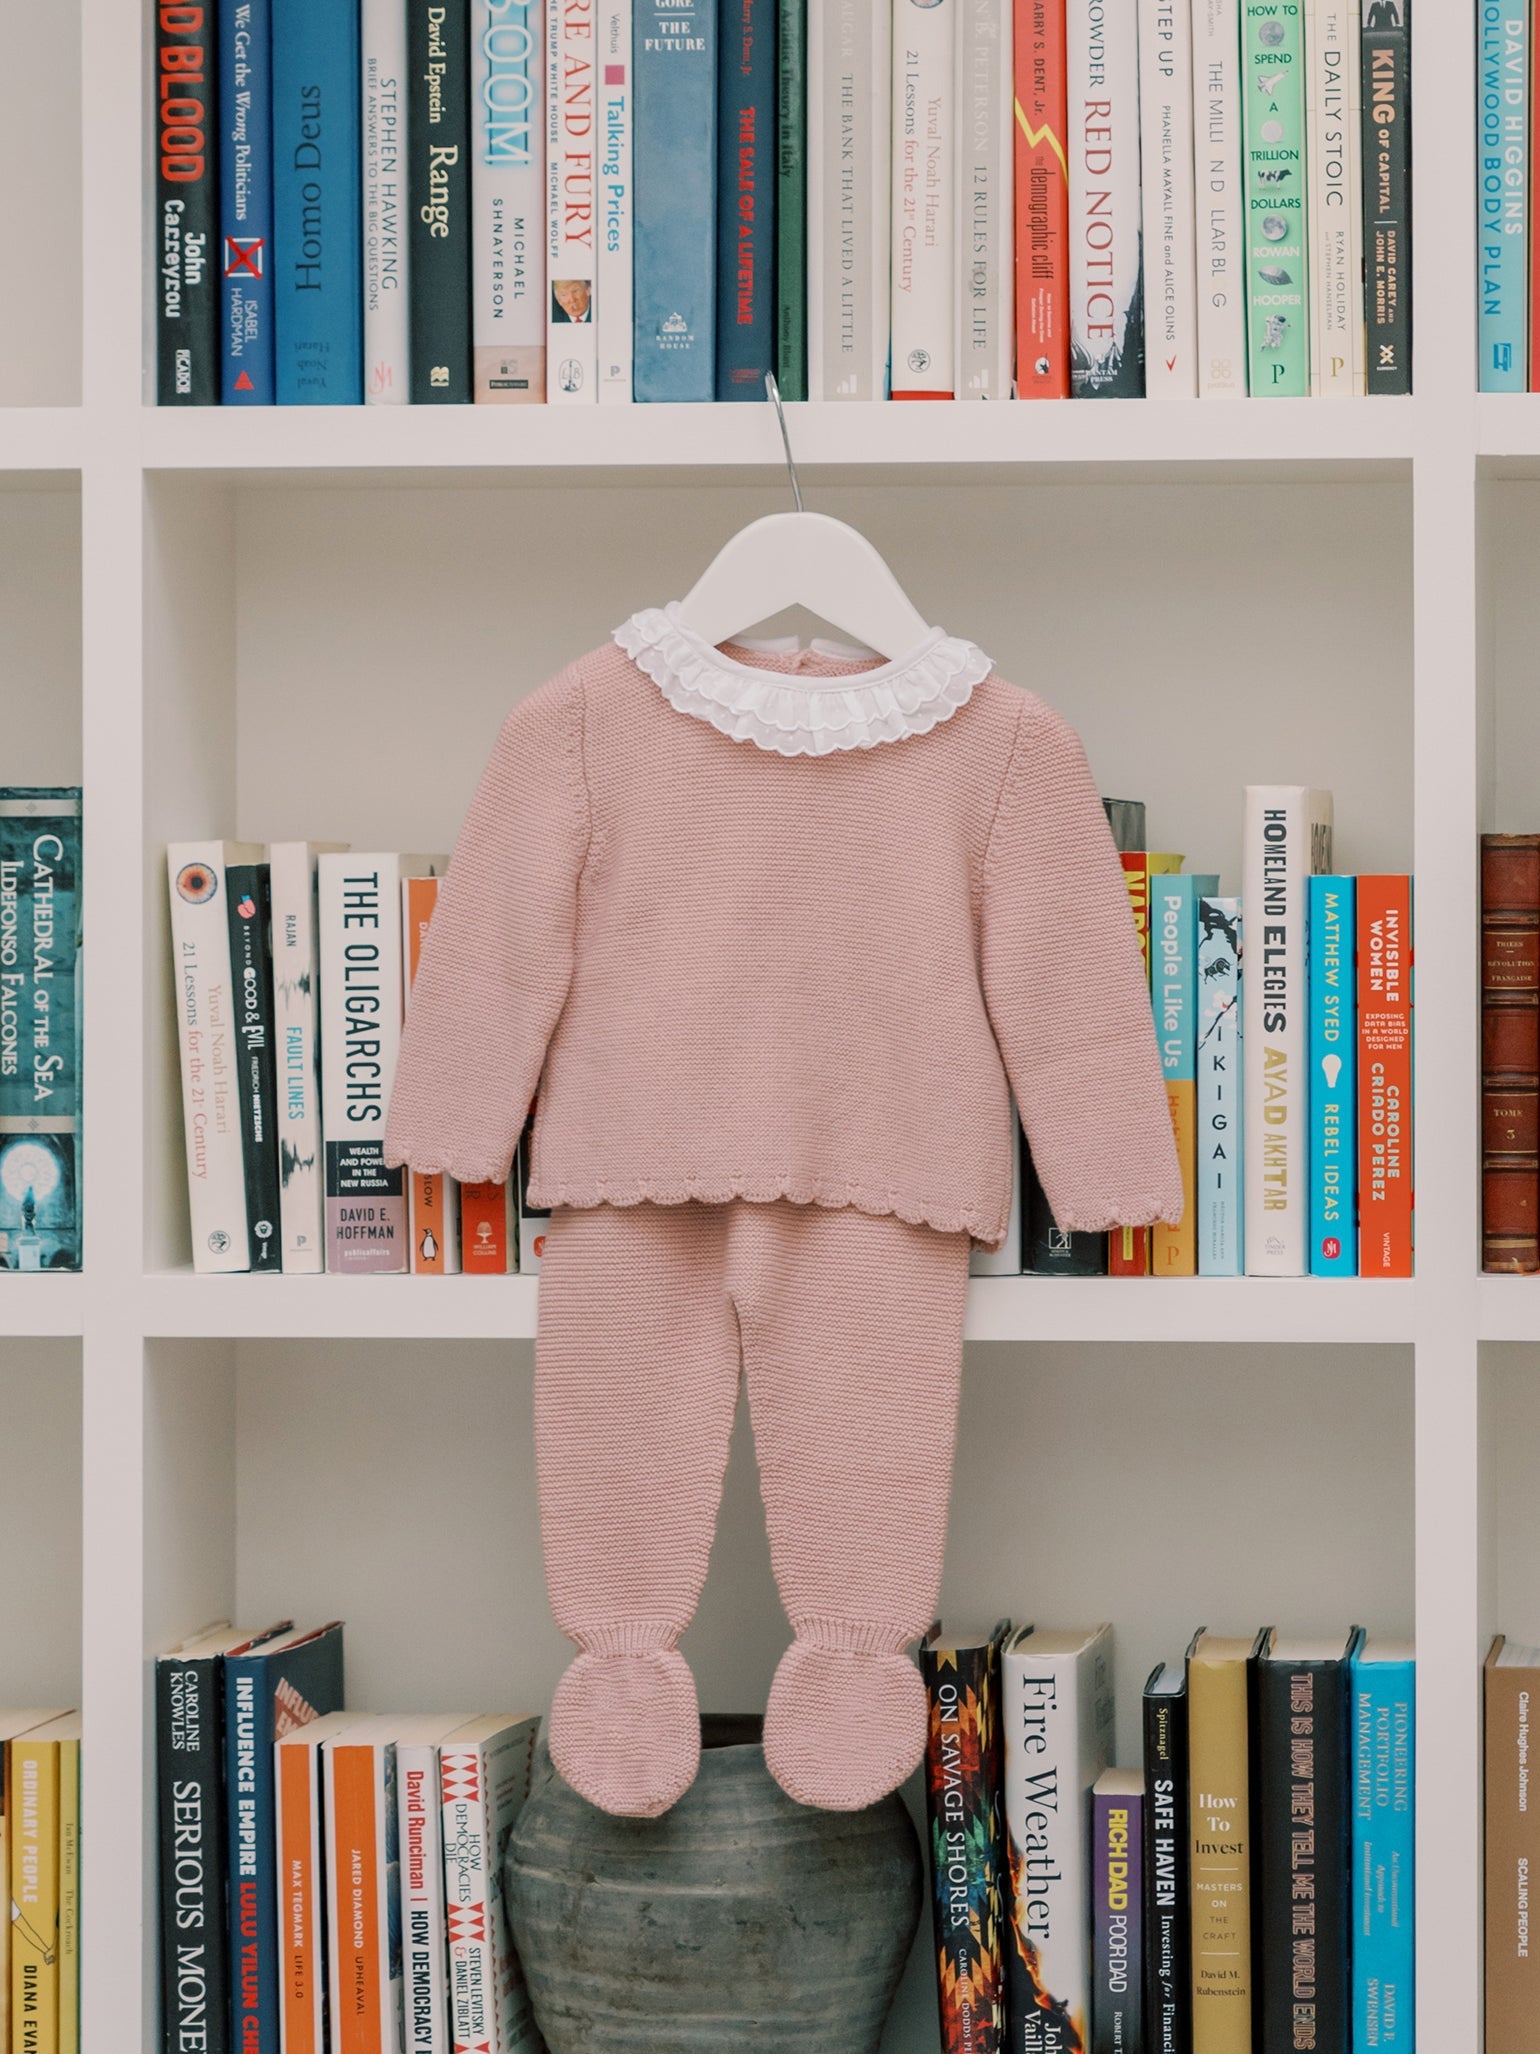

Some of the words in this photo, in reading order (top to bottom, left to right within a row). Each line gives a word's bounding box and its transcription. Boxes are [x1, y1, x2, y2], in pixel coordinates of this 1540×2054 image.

[235, 4, 250, 28] We
[659, 22, 690, 34] THE
[1247, 6, 1278, 17] HOW
[1282, 5, 1298, 16] TO
[1326, 14, 1336, 41] THE
[235, 32, 250, 59] Get
[610, 14, 620, 54] Velthuis
[645, 38, 705, 50] FUTURE
[235, 63, 250, 86] the
[366, 58, 376, 90] BRIEF
[1484, 0, 1500, 147] OLLYWOOD
[1505, 20, 1522, 104] DAVID
[841, 74, 853, 108] THE
[1324, 51, 1342, 121] DAILY
[232, 91, 251, 141] Wrong
[367, 96, 377, 156] ANSWERS
[602, 96, 624, 176] Talking
[739, 108, 755, 142] THE
[841, 115, 853, 160] BANK
[1084, 100, 1112, 176] RED
[1161, 106, 1172, 164] PHANELLA
[368, 162, 377, 178] TO
[738, 148, 754, 190] SALE
[973, 166, 988, 184] 12
[1250, 150, 1300, 161] TRILLION
[1325, 131, 1344, 206] STOIC
[1505, 116, 1522, 236] HIGGINS
[234, 145, 251, 220] Politicians
[368, 184, 377, 206] THE
[420, 145, 458, 238] Range
[550, 162, 558, 215] MICHAEL
[841, 167, 853, 214] THAT
[1163, 168, 1173, 212] MAYALL
[1250, 198, 1301, 209] DOLLARS
[1484, 158, 1500, 232] BODY
[368, 212, 378, 232] BIG
[607, 185, 624, 252] Prices
[738, 196, 754, 220] OF
[972, 191, 987, 253] RULES
[1026, 168, 1055, 251] demographic
[1164, 216, 1174, 241] FINE
[550, 220, 558, 260] WOLFF
[739, 226, 754, 238] A
[841, 220, 853, 270] LIVED
[1335, 231, 1346, 266] RYAN
[162, 200, 184, 318] Carreyrou
[185, 232, 205, 284] John
[367, 237, 378, 310] QUESTIONS
[492, 199, 504, 319] SHNAYERSON
[514, 218, 525, 300] MICHAEL
[1032, 254, 1053, 279] cliff
[1085, 190, 1114, 340] NOTICE
[1164, 245, 1174, 265] and
[738, 242, 754, 326] LIFETIME
[841, 277, 853, 287] A
[972, 260, 987, 298] FOR
[1164, 270, 1176, 300] ALICE
[1484, 246, 1500, 315] PLAN
[841, 293, 853, 354] LITTLE
[1165, 305, 1176, 342] OLINS
[1336, 272, 1346, 332] HOLIDAY
[972, 307, 987, 350] LIFE
[176, 350, 190, 394] PICADOR
[1263, 809, 1288, 916] HOMELAND
[182, 942, 196, 959] 21
[286, 916, 298, 948] RAJAN
[1158, 895, 1182, 976] People
[1325, 892, 1340, 987] MATTHEW
[184, 964, 200, 1026] Lessons
[1264, 925, 1288, 1032] ELEGIES
[206, 985, 226, 1028] Yuval
[1162, 984, 1181, 1032] Like
[1325, 995, 1340, 1042] SYED
[34, 1016, 50, 1043] THE
[188, 1030, 204, 1053] for
[286, 1027, 302, 1070] FAULT
[189, 1058, 204, 1083] the
[210, 1034, 228, 1076] Noah
[250, 1056, 260, 1092] FRIEDRICH
[1163, 1040, 1181, 1068] Us
[213, 1080, 231, 1134] Harari
[287, 1076, 304, 1120] LINES
[1264, 1046, 1288, 1124] AYAD
[252, 1094, 262, 1142] NIETZSCHE
[1324, 1104, 1340, 1157] REBEL
[1494, 1108, 1523, 1116] TOME
[188, 1114, 208, 1180] Century
[340, 1180, 359, 1188] NEW
[360, 1179, 388, 1188] RUSSIA
[352, 1168, 361, 1176] IN
[364, 1168, 376, 1176] THE
[1264, 1132, 1288, 1210] AKHTAR
[1325, 1164, 1340, 1220] IDEAS
[170, 1672, 186, 1749] KNOWLES
[184, 1671, 200, 1752] CAROLINE
[938, 1683, 958, 1722] ON
[1023, 1673, 1058, 1754] Fire
[1291, 1672, 1314, 1712] THIS
[1519, 1691, 1530, 1722] Claire
[236, 1677, 256, 1792] INFLUENCE
[1291, 1716, 1313, 1734] IS
[1517, 1724, 1530, 1764] Hughes
[940, 1733, 964, 1822] SAVAGE
[1291, 1738, 1314, 1778] HOW
[1358, 1692, 1372, 1820] MANAGEMENT
[1376, 1706, 1390, 1806] PORTFOLIO
[1394, 1702, 1408, 1811] PIONEERING
[22, 1760, 37, 1838] ORDINARY
[406, 1770, 424, 1812] David
[1292, 1782, 1314, 1826] THEY
[1518, 1766, 1530, 1812] Johnson
[172, 1781, 204, 1929] SERIOUS
[238, 1800, 256, 1876] EMPIRE
[408, 1817, 427, 1890] Runciman
[454, 1804, 471, 1902] DEMOCRACIES
[468, 1834, 482, 1870] HOW
[1023, 1765, 1062, 1940] Weather
[1195, 1838, 1244, 1856] Invest
[1292, 1830, 1314, 1870] TELL
[23, 1845, 38, 1904] PEOPLE
[292, 1860, 302, 1887] MAX
[946, 1832, 970, 1926] SHORES
[1196, 1884, 1243, 1892] MASTERS
[1292, 1873, 1314, 1900] ME
[66, 1890, 74, 1905] The
[292, 1891, 303, 1948] TEGMARK
[1210, 1916, 1228, 1924] THE
[1212, 1900, 1228, 1908] ON
[1292, 1903, 1314, 1934] THE
[65, 1908, 74, 1954] Cockroach
[411, 1911, 428, 1945] HOW
[1202, 1932, 1237, 1940] CRAFT
[468, 1947, 482, 1986] STEVEN
[958, 1948, 969, 1998] CAROLINE
[1292, 1938, 1315, 1998] WORLD
[177, 1944, 207, 2054] MONE
[412, 1951, 432, 2045] DEMOCRACY
[470, 1988, 484, 2036] LEVITSKY
[1196, 1986, 1246, 1996] Rubenstein
[1366, 1978, 1379, 2046] SWENSEN
[960, 2002, 971, 2038] DODDS
[1294, 2003, 1316, 2050] ENDS
